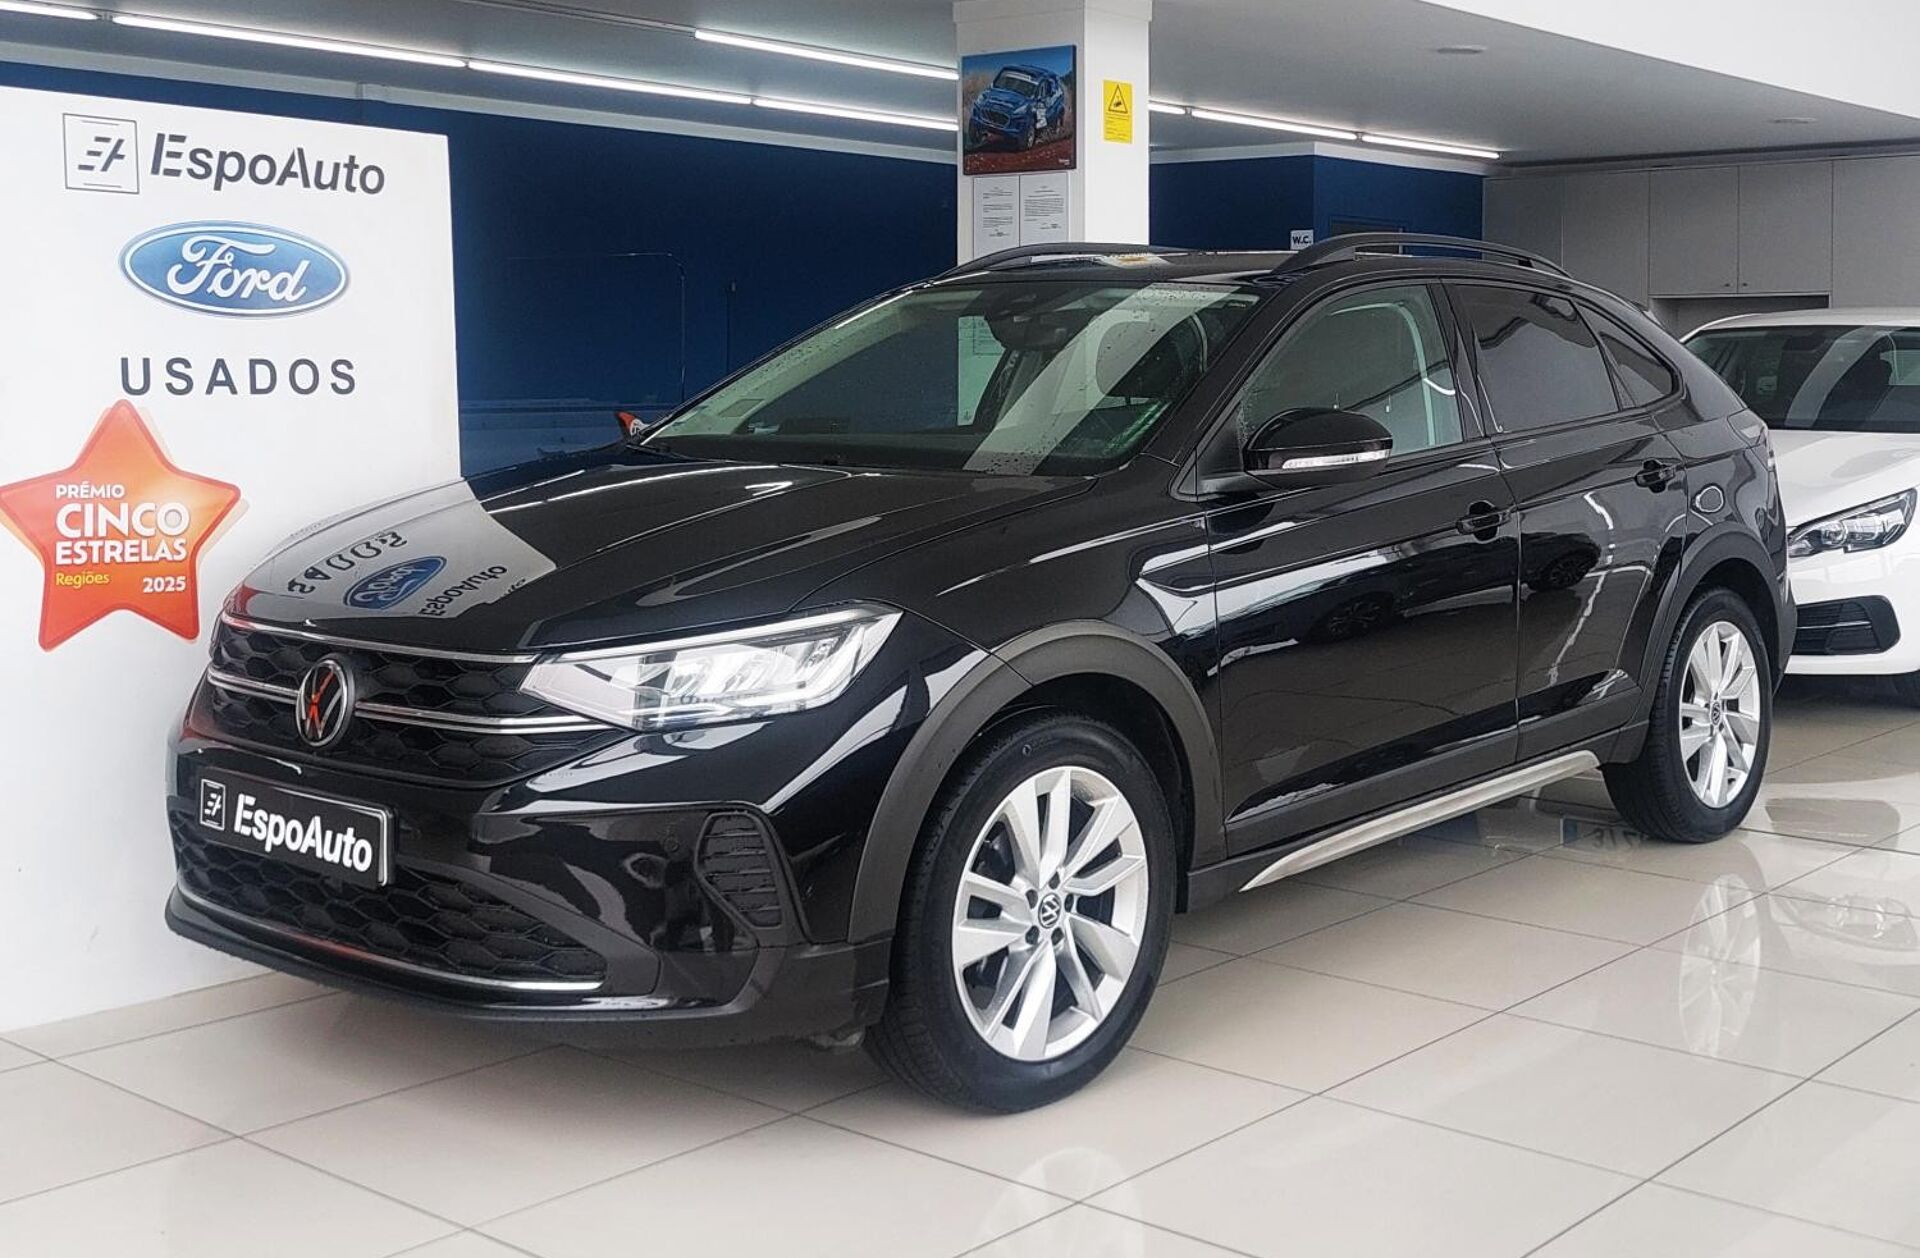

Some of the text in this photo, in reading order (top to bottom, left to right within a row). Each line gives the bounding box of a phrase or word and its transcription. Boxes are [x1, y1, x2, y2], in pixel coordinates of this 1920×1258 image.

[150, 132, 386, 195] EspoAuto
[166, 234, 310, 303] Ford
[120, 356, 357, 396] USADOS
[55, 481, 125, 499] PRÉMIO
[56, 502, 190, 538] CINCO
[55, 538, 188, 565] ESTRELAS
[55, 571, 110, 588] Regiões
[142, 576, 187, 593] 2025
[233, 793, 373, 872] EspoAuto
